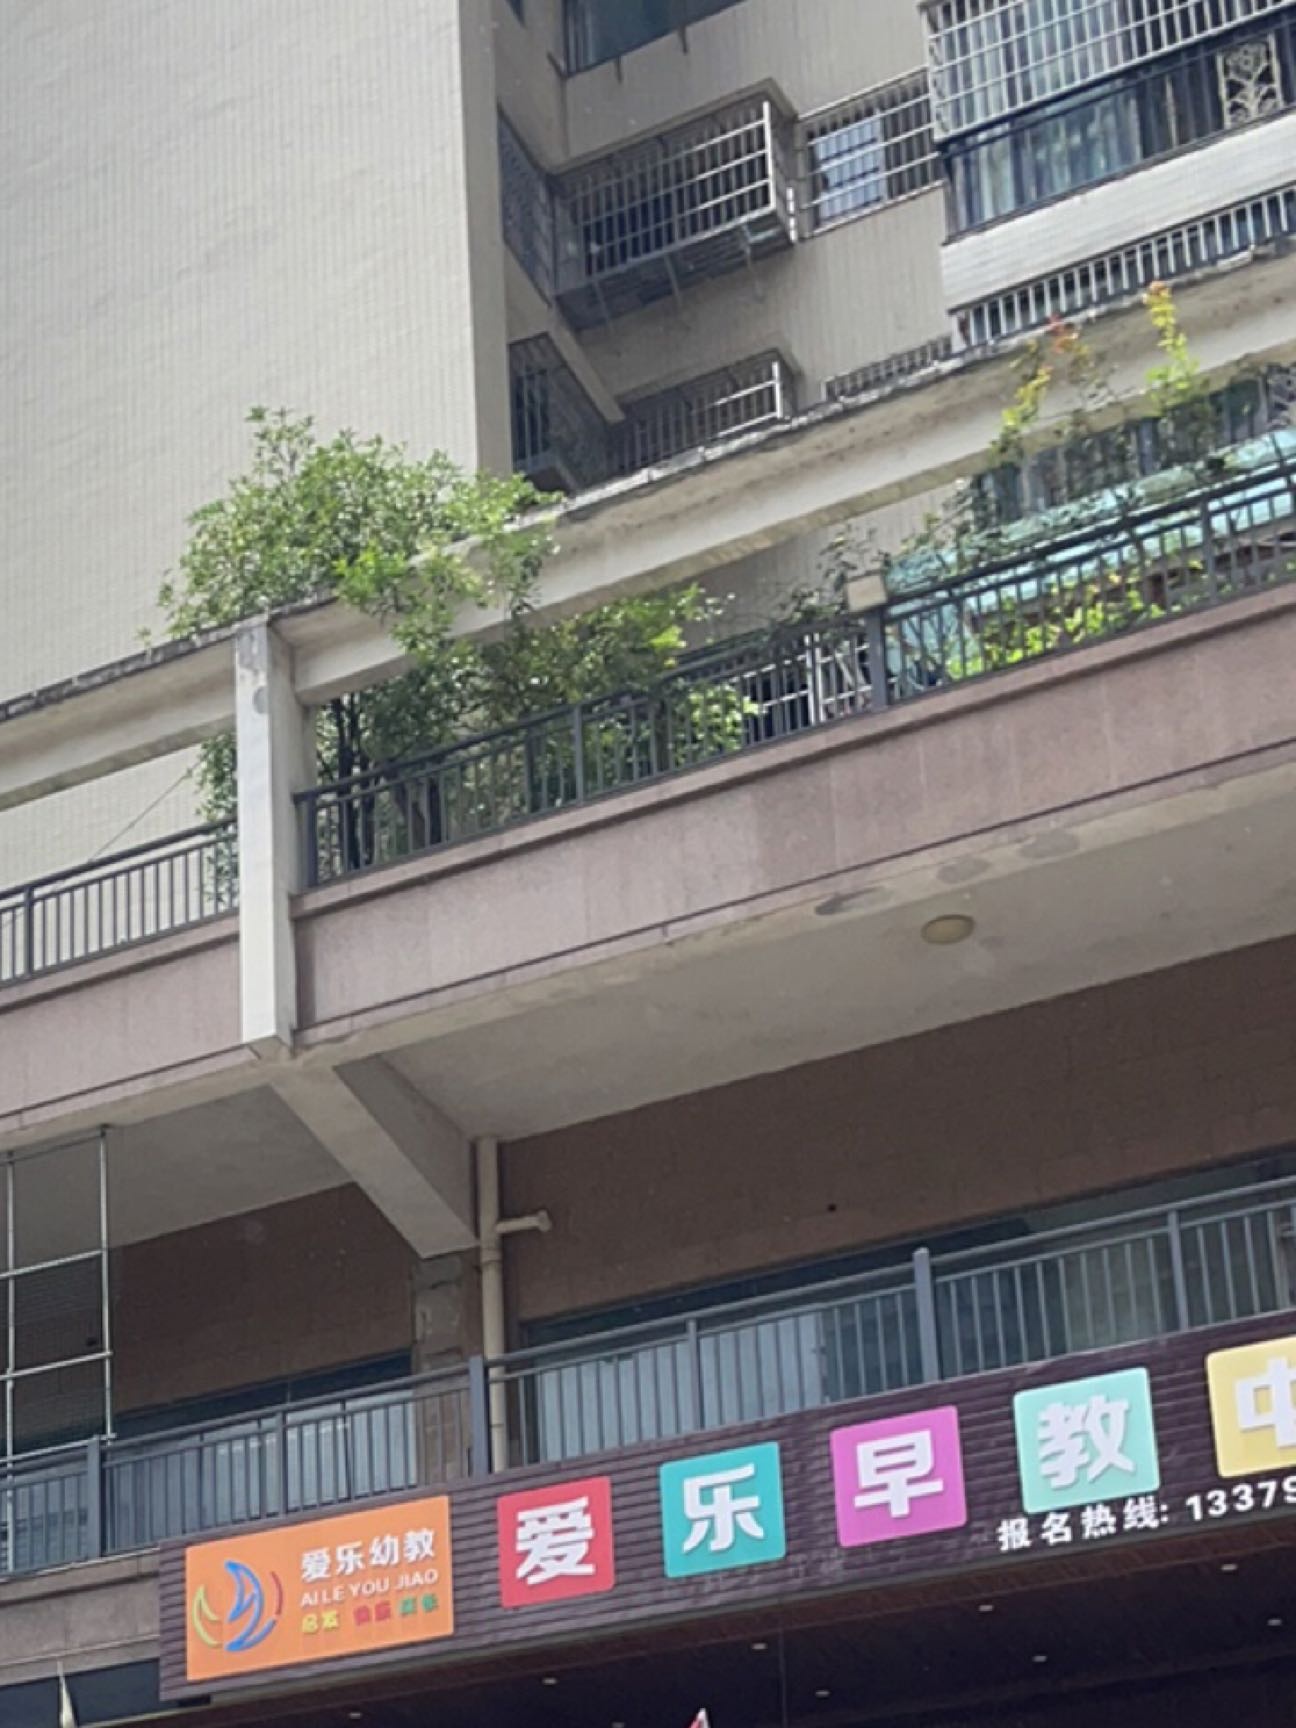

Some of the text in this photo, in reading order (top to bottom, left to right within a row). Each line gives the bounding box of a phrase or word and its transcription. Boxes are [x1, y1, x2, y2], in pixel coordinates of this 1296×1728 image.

[301, 1528, 435, 1582] 爱乐幼教
[349, 1577, 390, 1598] YOU
[395, 1569, 439, 1591] JIAO
